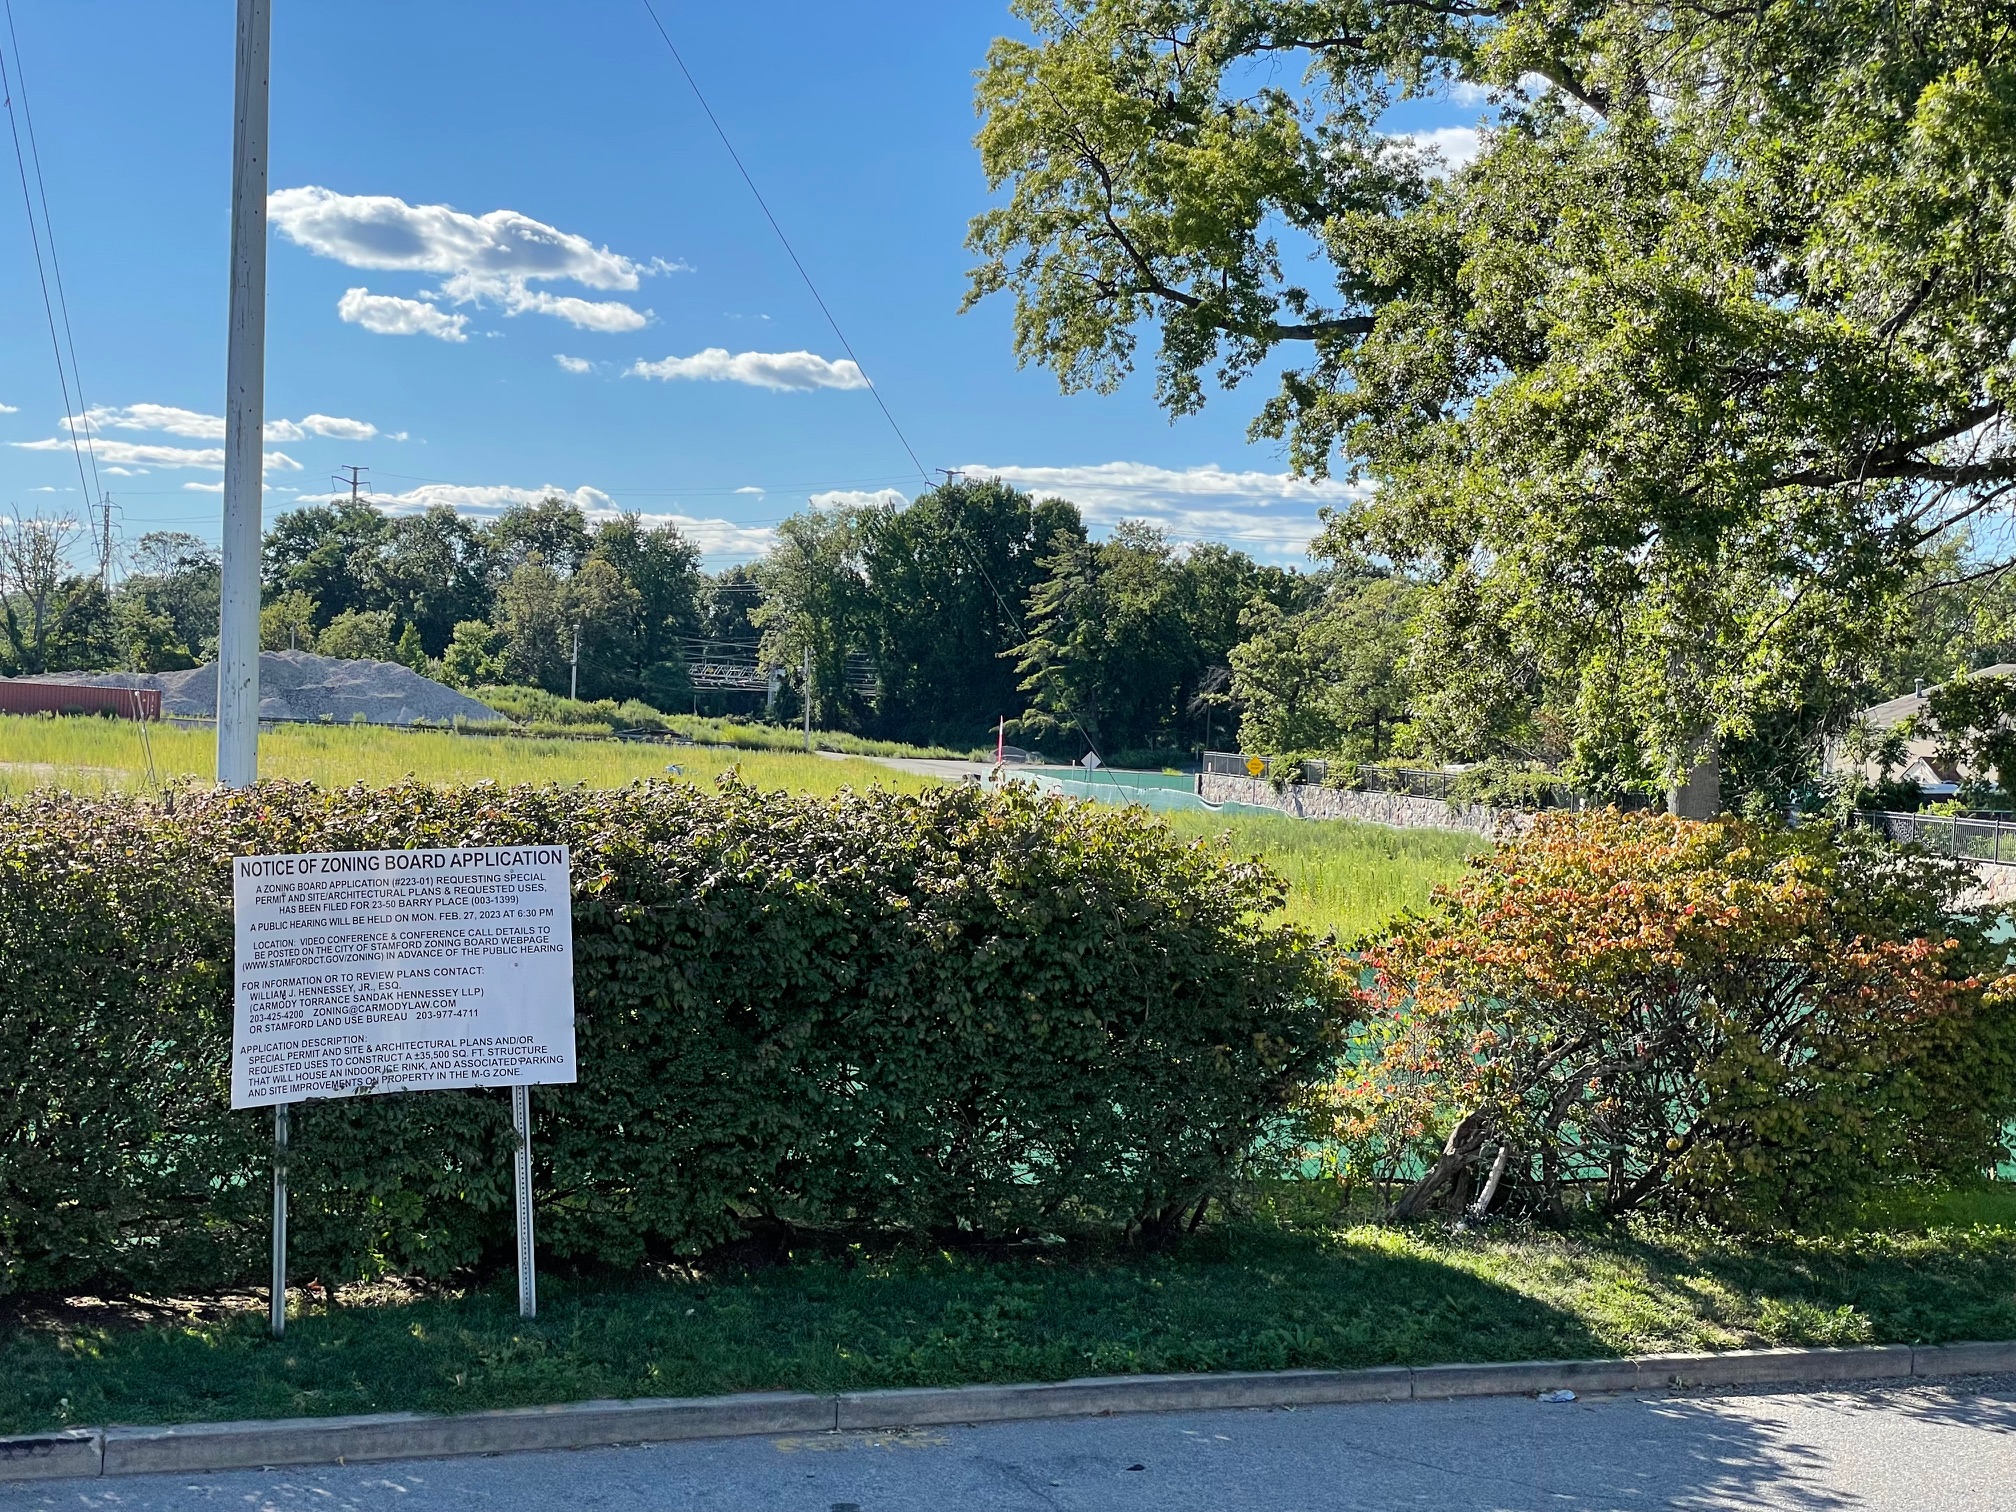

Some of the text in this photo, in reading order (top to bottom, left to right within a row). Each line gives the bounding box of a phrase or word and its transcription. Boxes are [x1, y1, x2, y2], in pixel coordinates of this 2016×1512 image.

[241, 850, 562, 877] NOTICE OF ZONING BOARD APPLICATION
[256, 894, 285, 904] PERMIT
[288, 893, 305, 902] AND
[308, 888, 406, 901] SITE/ARCHITECTURAL
[454, 885, 514, 894] REQUESTED
[518, 884, 547, 892] USES,
[264, 884, 295, 893] ZONING
[298, 882, 327, 891] BOARD
[329, 879, 389, 888] APPLICATION
[392, 877, 433, 887] (#223-01)
[437, 875, 500, 884] REQUESTING
[504, 873, 546, 882] SPECIAL
[279, 895, 519, 914] HAS BEEN FILED FOR 23-50 BARRY PLACE (003-1399)
[258, 921, 287, 931] PUBLIC
[290, 919, 327, 929] HEARING
[329, 917, 350, 926] WILL
[368, 915, 392, 923] HELD
[464, 911, 477, 920] 27,
[480, 910, 500, 919] 2023
[254, 939, 296, 949] LOCATION:
[300, 937, 325, 946] VIDEO
[328, 933, 388, 944] CONFERENCE
[400, 929, 465, 939] CONFERENCE
[496, 927, 535, 935] DETAILS
[268, 949, 299, 958] POSTED
[302, 947, 313, 955] ON
[316, 946, 332, 954] THE
[335, 944, 354, 953] CITY
[371, 941, 422, 950] STAMFORD
[425, 939, 461, 948] ZONING
[464, 937, 498, 946] BOARD
[501, 936, 549, 944] WEBPAGE
[242, 952, 384, 972] (WWW.STAMFORDCT.GOV/ZONING)
[386, 951, 396, 959] IN
[398, 949, 442, 958] ADVANCE
[483, 946, 517, 954] PUBLIC
[521, 945, 564, 953] HEARING
[242, 982, 259, 990] FOR
[262, 975, 322, 988] INFORMATION
[325, 974, 338, 983] OR
[356, 971, 394, 980] REVIEW
[397, 969, 430, 978] PLANS
[434, 967, 484, 976] CONTACT:
[250, 990, 286, 1000] WILLIAM
[299, 985, 355, 997] HENNESSEY,
[358, 983, 375, 992] JR.,
[379, 982, 401, 990] ESQ.
[250, 988, 484, 1013] (CARMODY TORRANCE SANDAK HENNESSEY LLP)
[250, 1000, 456, 1023] 203-425-4200 ZONING@CARMODYLAW.COM
[250, 1009, 478, 1034] OR STAMFORD LAND USE BUREAU 203-977-4711
[240, 1035, 368, 1054] APPLICATION DESCRIPTION:
[249, 1054, 285, 1064] SPECIAL
[288, 1051, 319, 1061] PERMIT
[322, 1048, 341, 1057] AND
[345, 1046, 363, 1054] SITE
[375, 1040, 457, 1052] ARCHITECTURAL
[460, 1038, 492, 1046] PLANS
[495, 1036, 533, 1045] AND/OR
[249, 1063, 301, 1076] REQUESTED
[305, 1060, 328, 1069] USES
[346, 1053, 403, 1065] CONSTRUCT
[488, 1046, 547, 1056] STRUCTURE
[249, 1077, 270, 1086] THAT
[273, 1074, 293, 1083] WILL
[296, 1071, 327, 1081] HOUSE
[345, 1066, 382, 1075] INDOOR
[383, 1064, 399, 1074] ICE
[402, 1062, 427, 1071] RINK,
[430, 1061, 450, 1069] AND
[454, 1058, 517, 1068] ASSOCIATED
[520, 1056, 564, 1064] PARKING
[248, 1088, 266, 1097] AND
[269, 1085, 288, 1094] SITE
[290, 1077, 362, 1092] IMPROVEMENTS
[366, 1076, 378, 1085] ON
[382, 1073, 434, 1083] PROPERTY
[493, 1068, 523, 1076] ZONE.
